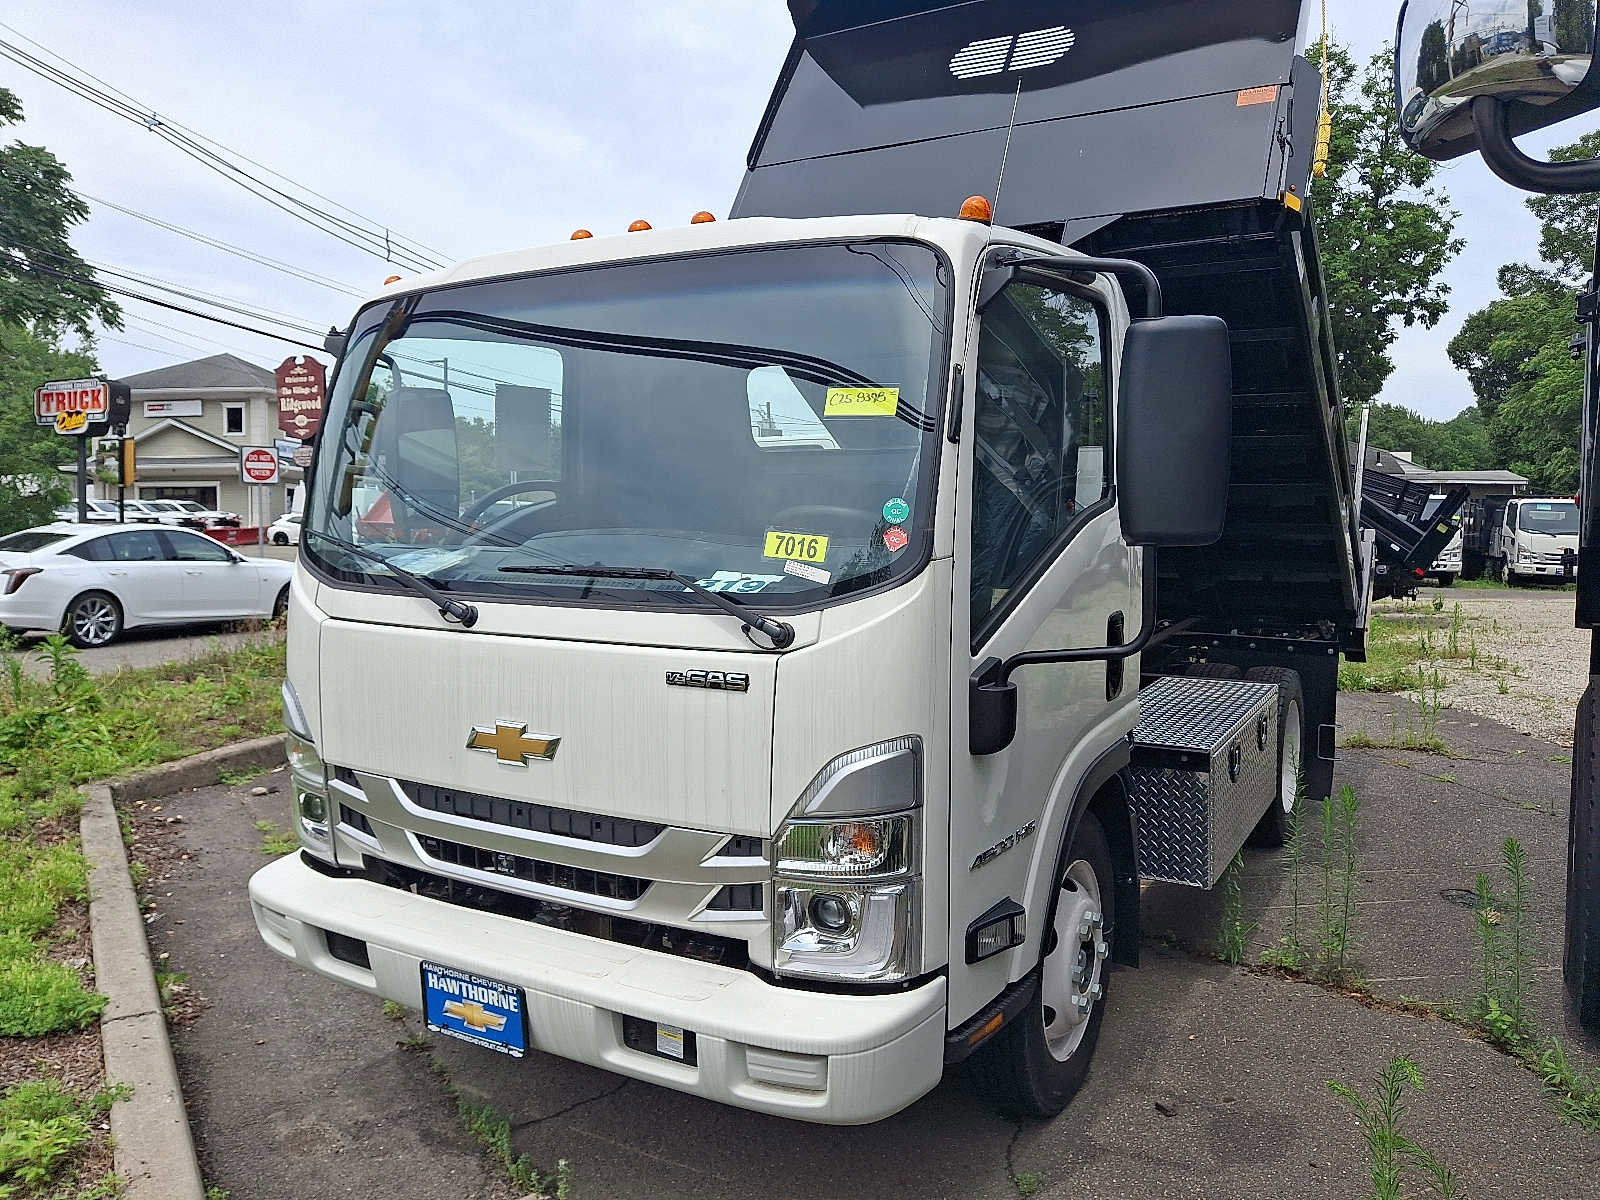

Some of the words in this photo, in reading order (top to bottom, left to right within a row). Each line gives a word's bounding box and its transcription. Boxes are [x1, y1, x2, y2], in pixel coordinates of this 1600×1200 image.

[41, 389, 102, 413] TRUCK
[279, 395, 322, 413] Ridgewood
[248, 454, 258, 462] DO
[259, 454, 271, 462] NOT
[250, 469, 271, 477] ENTER
[775, 534, 819, 559] 7016
[890, 536, 901, 544] QC
[686, 669, 749, 692] GAS
[422, 962, 470, 982] HAWTHORNE
[471, 976, 517, 995] CHEVROLET
[427, 972, 519, 1013] HAWTHORNE
